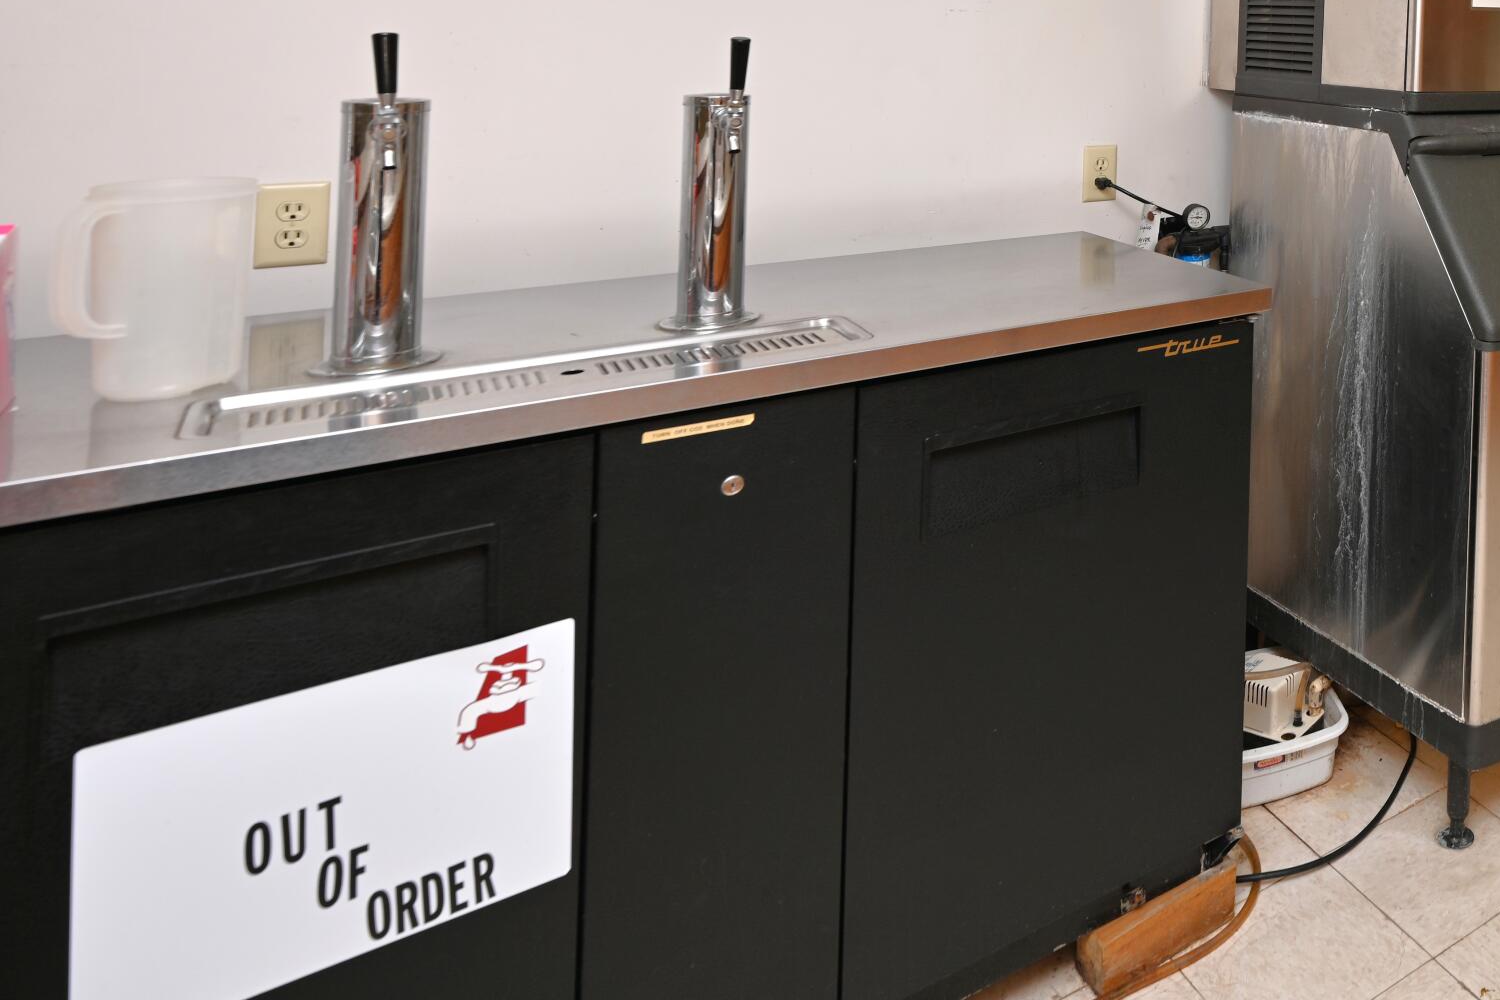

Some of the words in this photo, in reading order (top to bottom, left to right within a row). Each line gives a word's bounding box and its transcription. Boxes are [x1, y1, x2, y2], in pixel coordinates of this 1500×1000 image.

[243, 795, 343, 875] OUT
[317, 843, 370, 909] OF
[366, 852, 497, 941] ORDER
